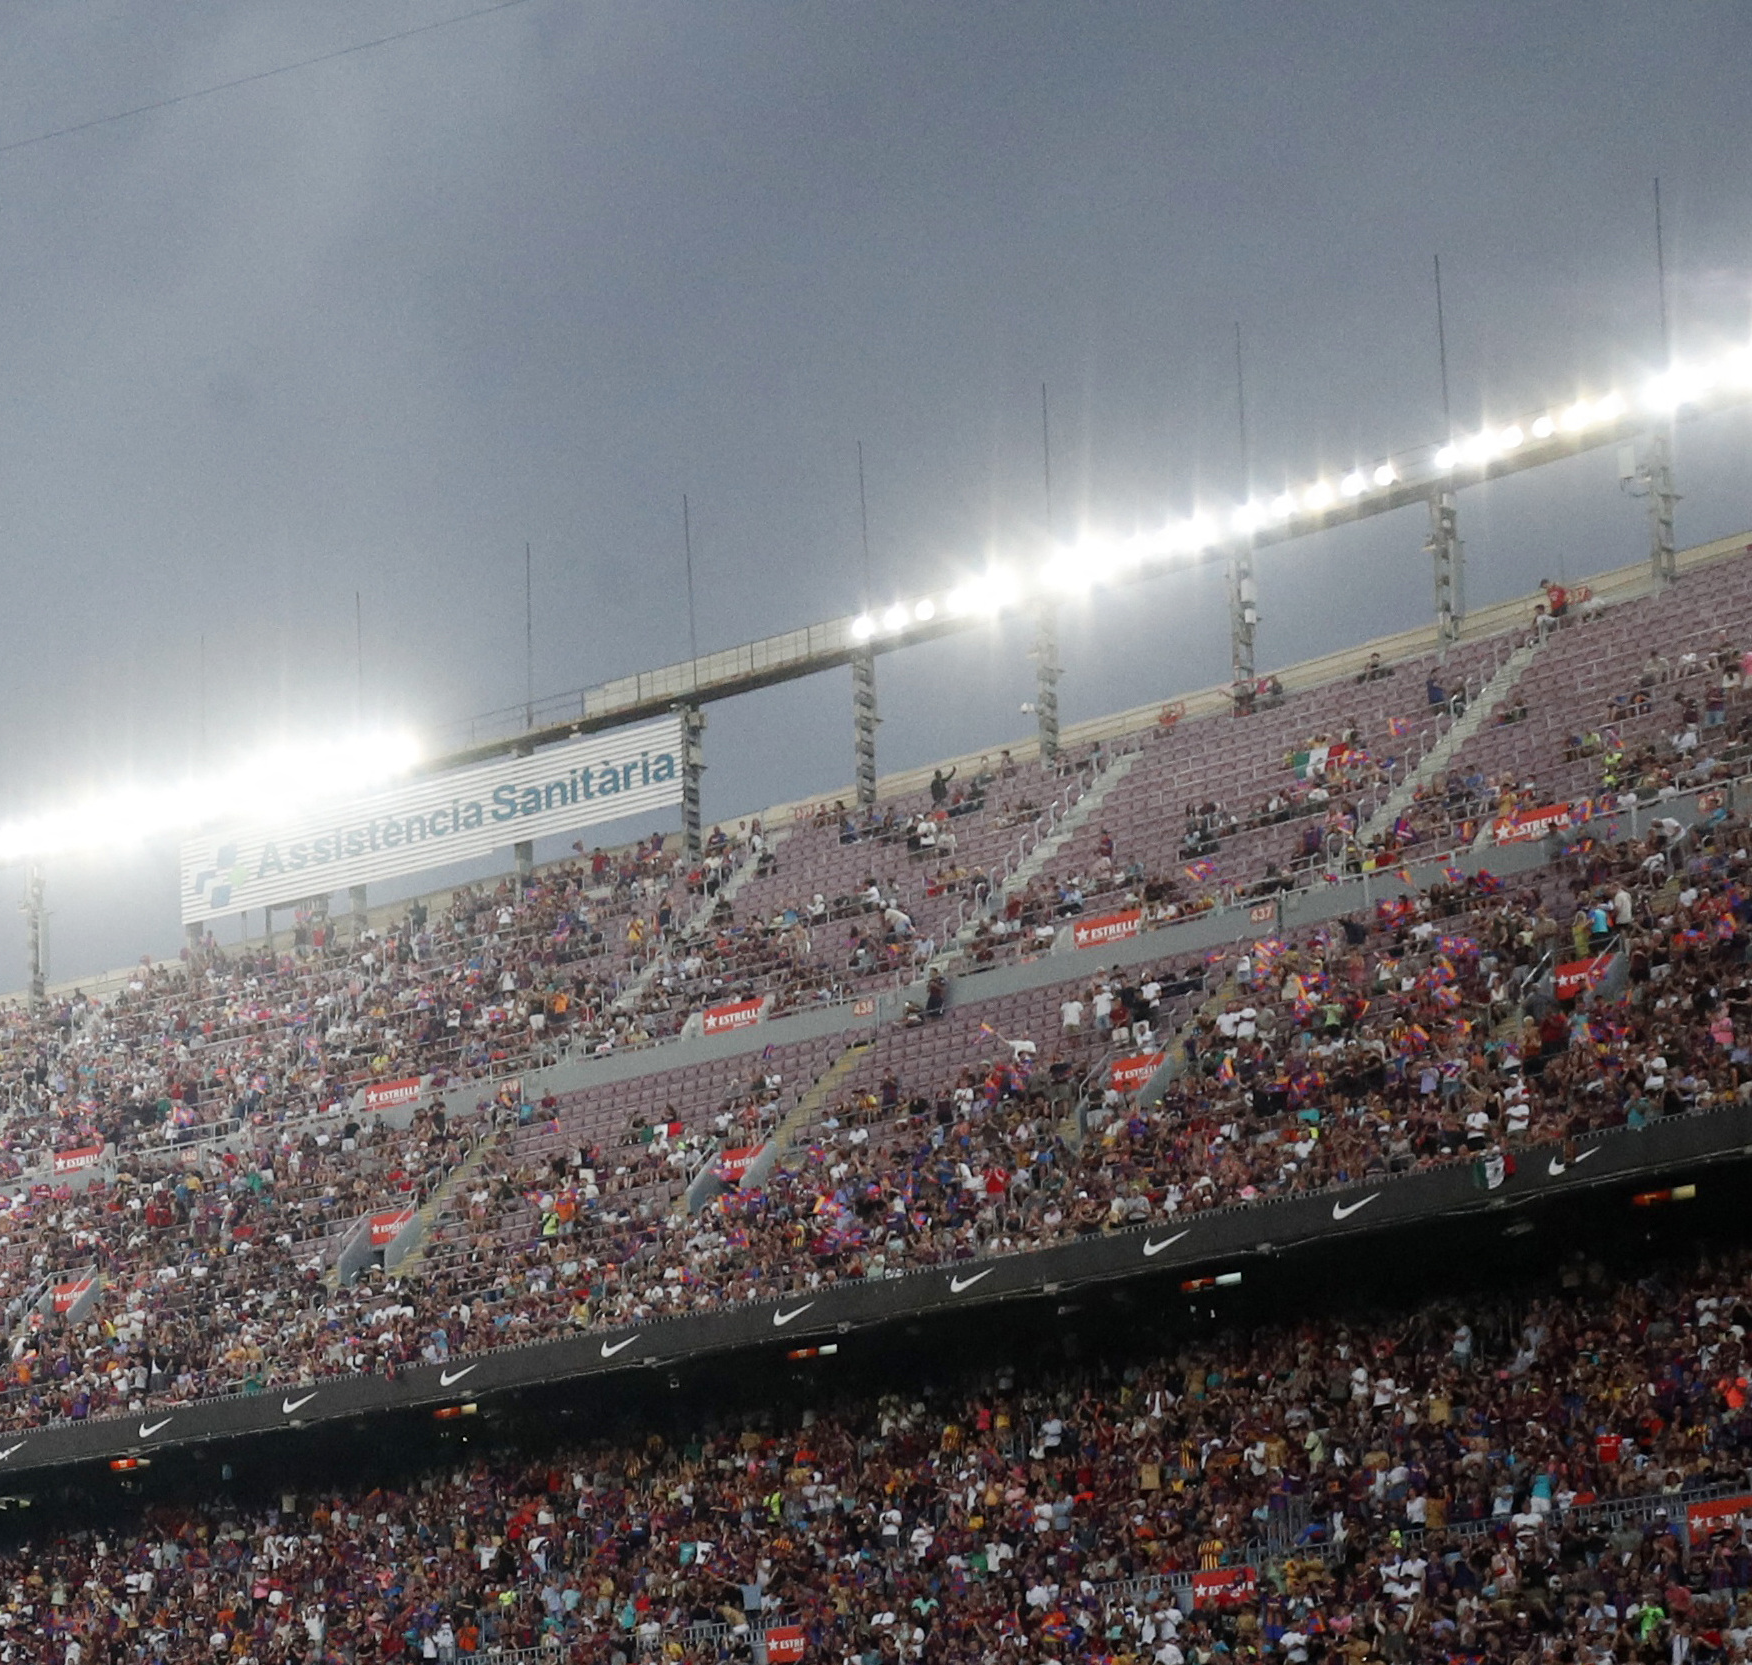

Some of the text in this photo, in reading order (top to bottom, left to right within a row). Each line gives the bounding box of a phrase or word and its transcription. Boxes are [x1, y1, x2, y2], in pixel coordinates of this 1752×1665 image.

[258, 751, 675, 879] Assistència Sanitària
[1251, 905, 1273, 922] 437
